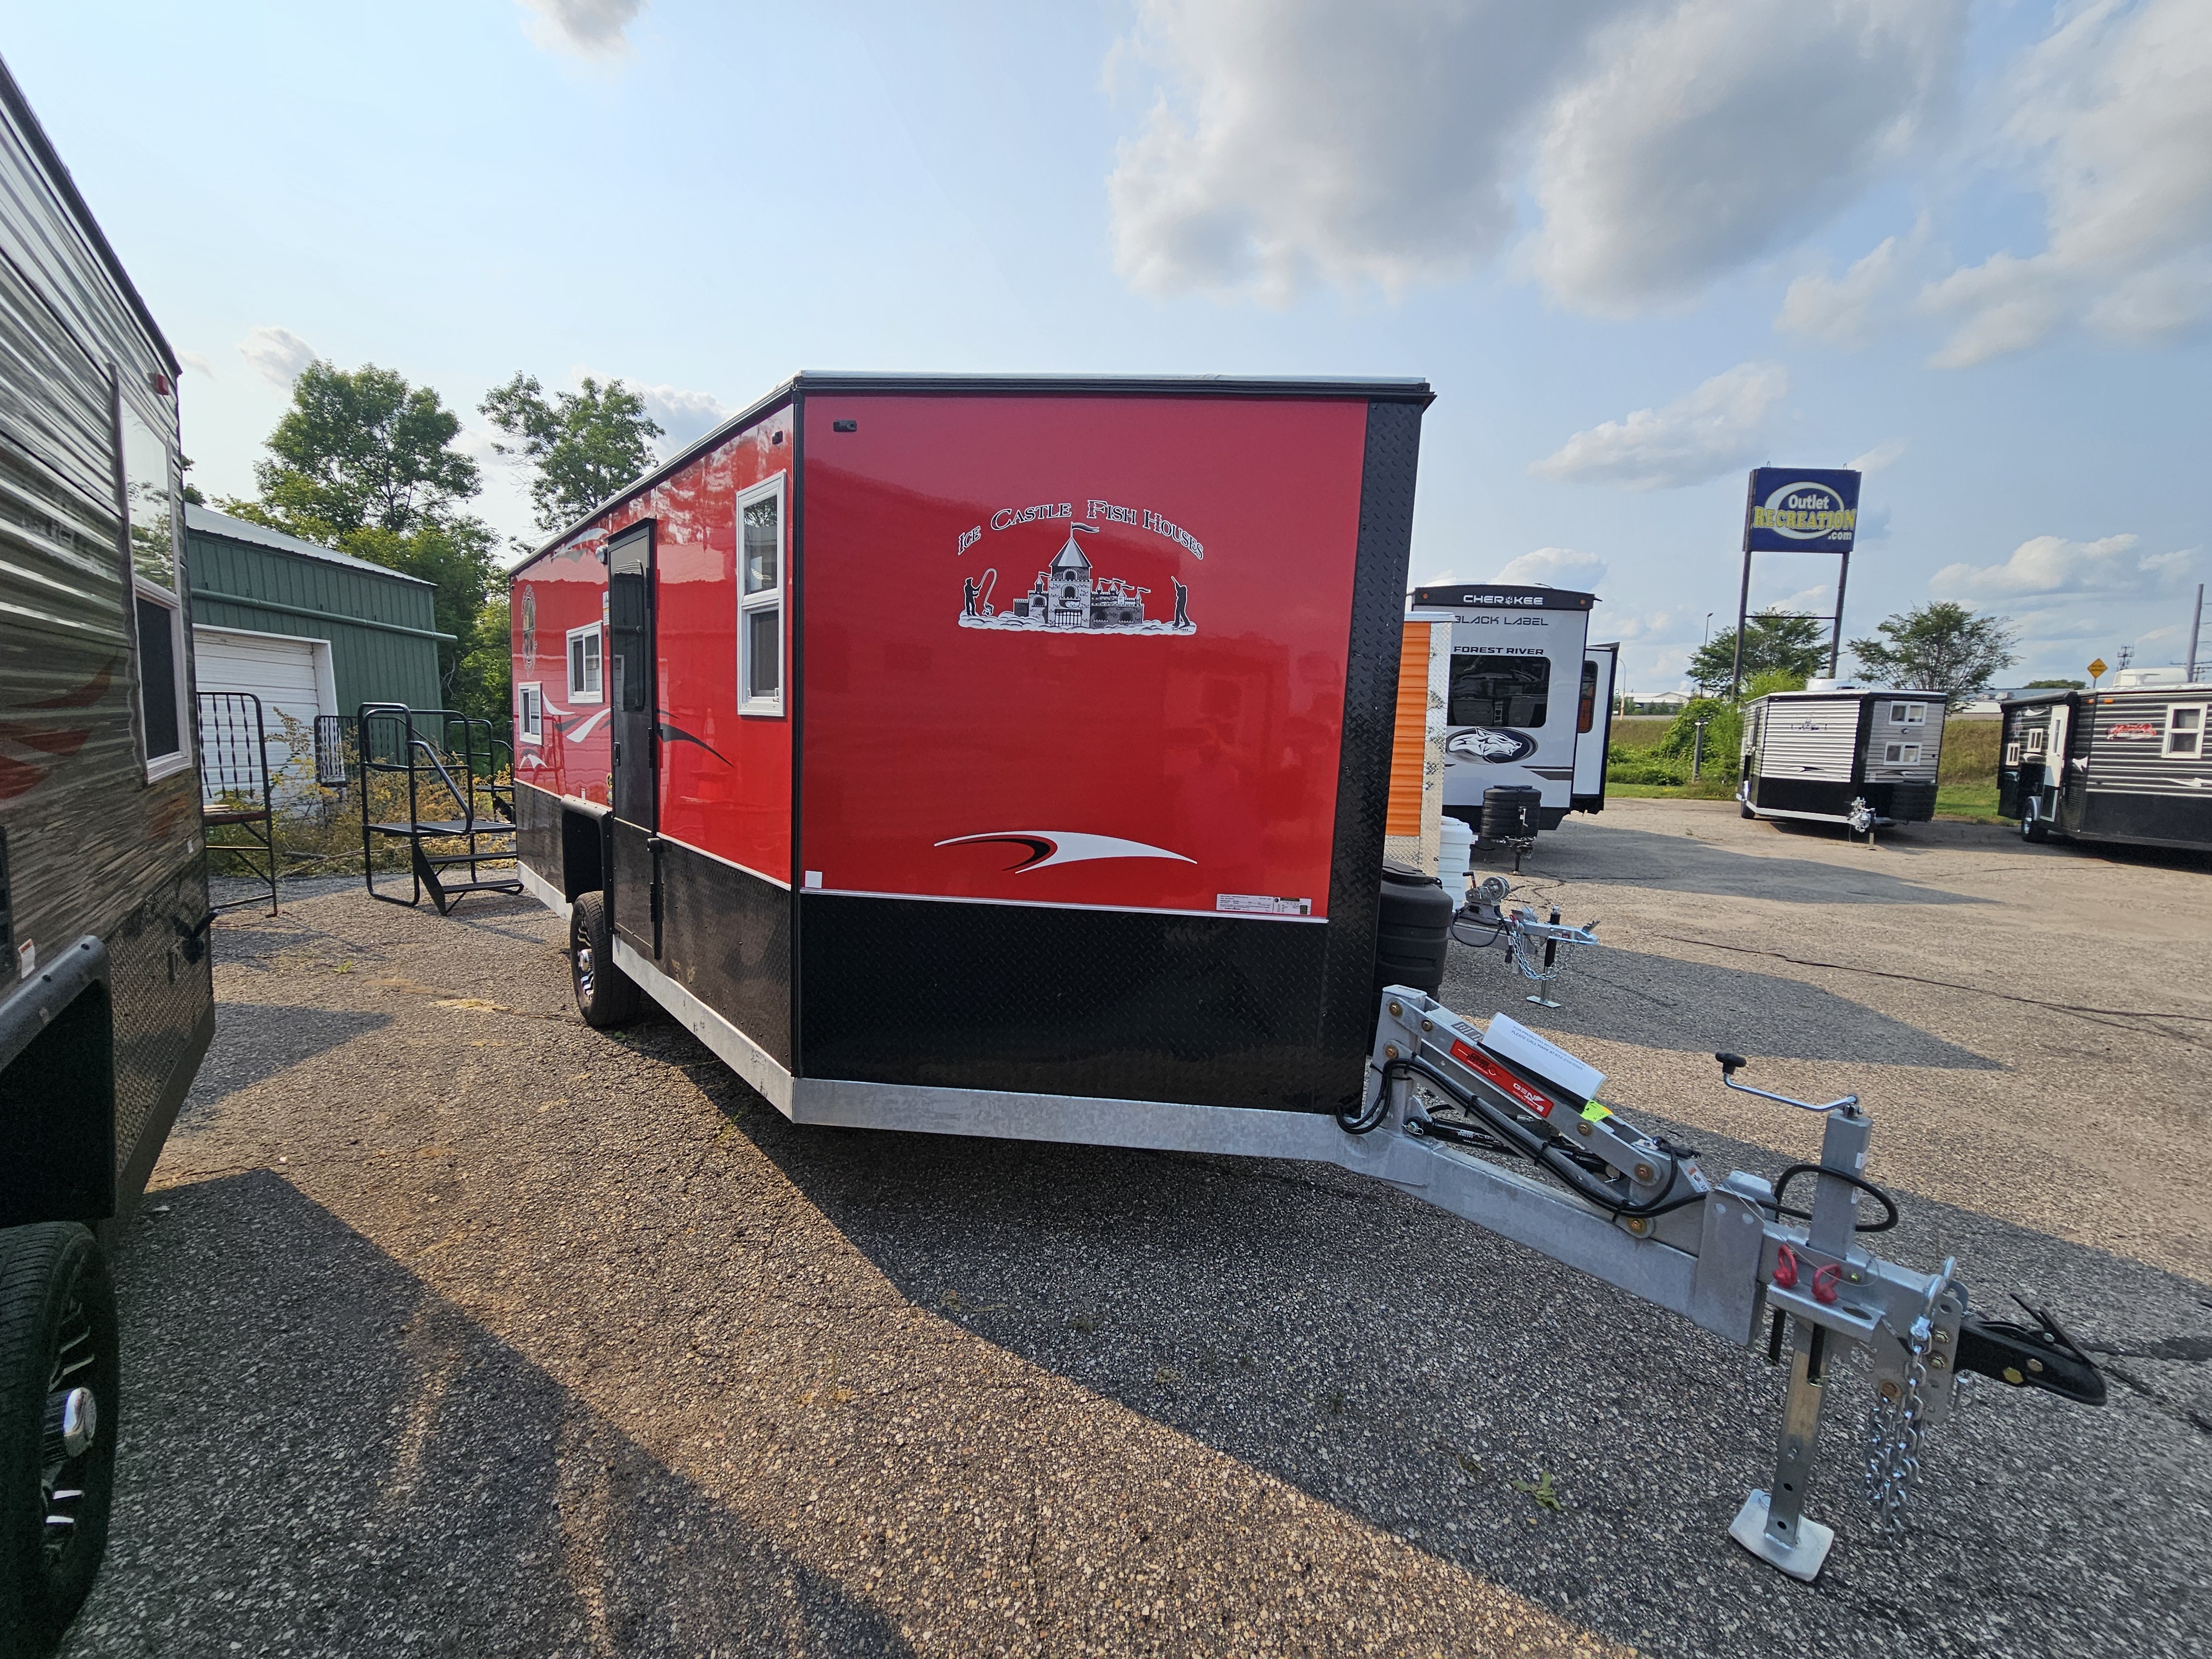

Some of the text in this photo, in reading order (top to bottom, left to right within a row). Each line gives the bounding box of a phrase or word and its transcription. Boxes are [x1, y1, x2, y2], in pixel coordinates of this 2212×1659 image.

[1788, 494, 1830, 509] Outlet
[1753, 506, 1857, 530] RECREATION
[958, 499, 1204, 560] ICE CASTLE FISH HOUSES
[1828, 531, 1852, 540] .com
[1454, 615, 1548, 625] BLACK LABEL
[1511, 1030, 1526, 1040] PLEASE
